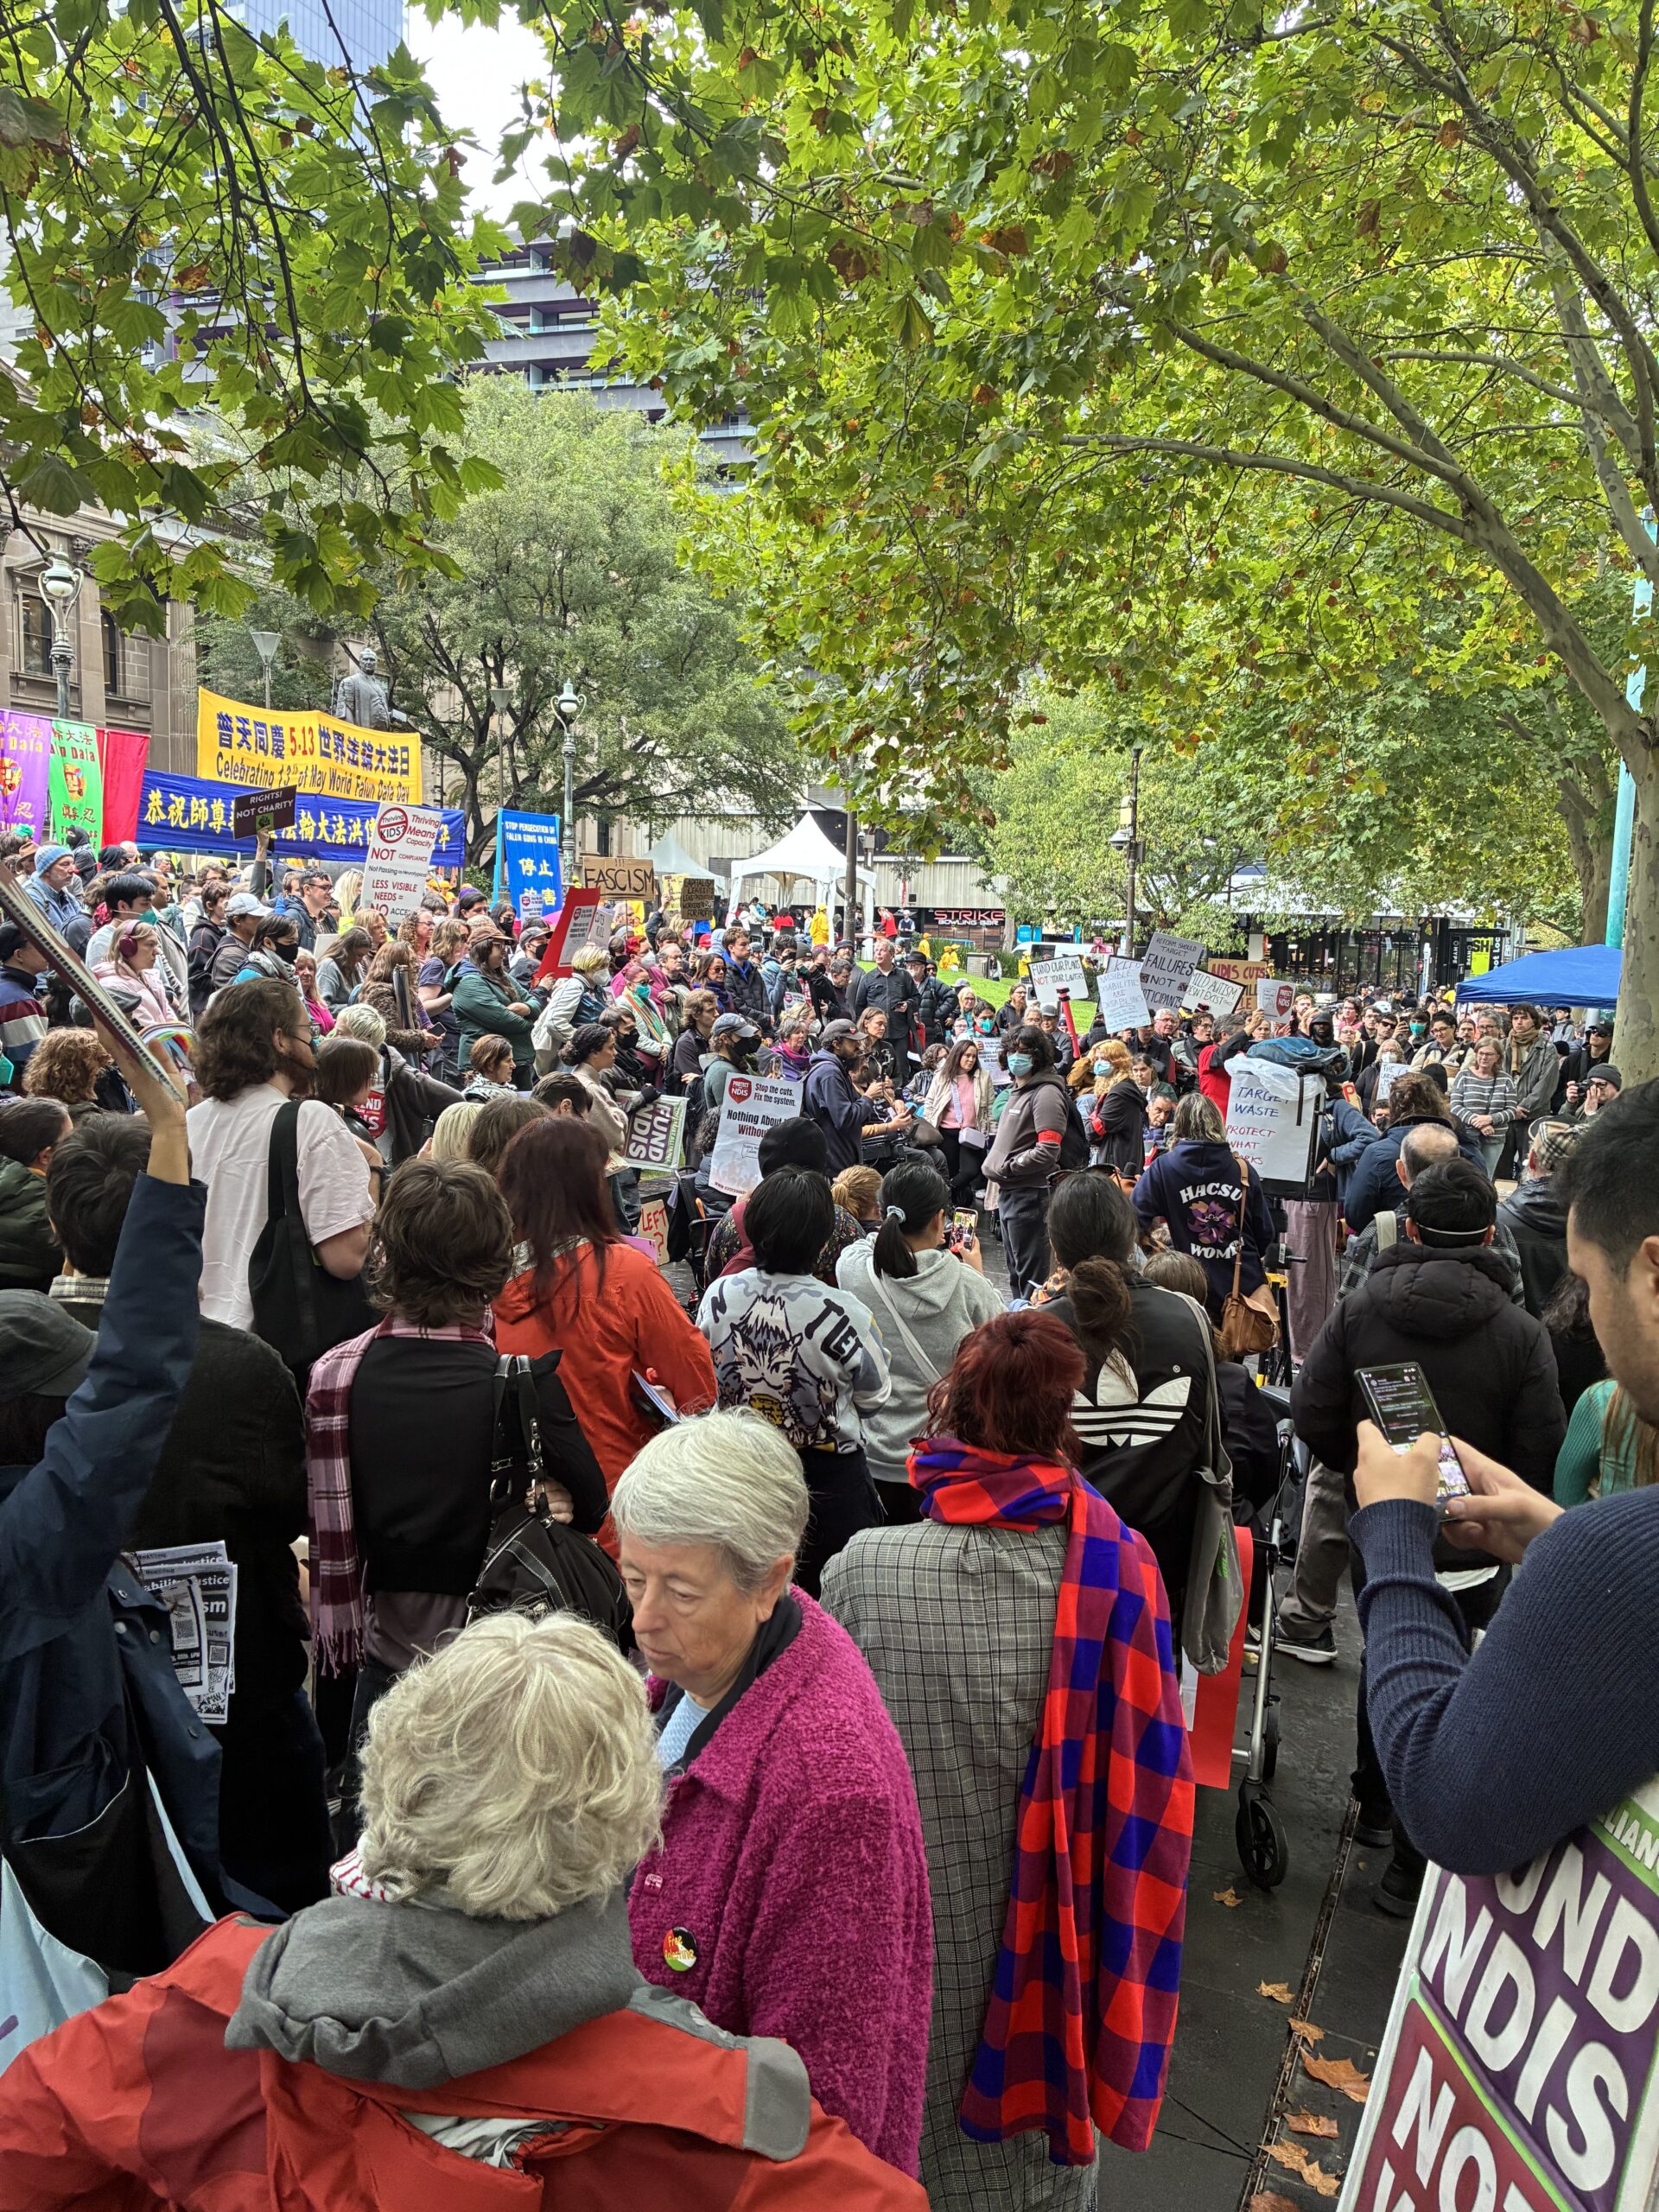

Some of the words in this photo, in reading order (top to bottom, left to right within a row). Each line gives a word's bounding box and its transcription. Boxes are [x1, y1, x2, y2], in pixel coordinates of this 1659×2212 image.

[216, 710, 285, 760] 普天同慶
[318, 723, 410, 778] 世界法輪大法日
[216, 751, 274, 788] Celebrating
[309, 764, 327, 793] May
[329, 767, 353, 791] World
[355, 774, 375, 799] Falun
[397, 781, 410, 804] Day
[250, 790, 283, 804] RIGHTS!
[144, 787, 235, 834] 恭祝師尊
[236, 808, 257, 819] NOT
[257, 799, 294, 815] CHARITY
[411, 814, 440, 829] Thriving
[505, 821, 518, 830] STOP
[380, 824, 406, 838] KIDS?
[407, 826, 436, 839] Means
[406, 837, 432, 849] Capacity
[371, 847, 397, 861] NOT
[398, 854, 429, 862] COMPLIANCE
[378, 866, 397, 875] Passing
[518, 857, 554, 877] 停止
[372, 879, 389, 889] LESS
[391, 881, 418, 893] VISIBLE
[585, 868, 655, 893] FASCISM
[374, 892, 397, 901] NEEDS
[934, 910, 1005, 921] STRIKE
[1160, 945, 1189, 957] TARGET
[1032, 963, 1051, 976] FUND
[1145, 953, 1196, 976] FAILURES
[1243, 966, 1266, 980] CUTS
[1033, 976, 1048, 986] NOT
[1149, 975, 1176, 988] NOT
[1208, 980, 1238, 1001] AUTISM
[1141, 988, 1184, 1009] RTICIPANTS
[731, 1088, 748, 1096] NDIS
[755, 1083, 769, 1093] Stop
[769, 1085, 779, 1094] the
[779, 1088, 794, 1096] cuts.
[1237, 1086, 1287, 1104] TARGE
[764, 1094, 773, 1103] the
[773, 1096, 796, 1107] system.
[727, 1109, 760, 1125] Nothing
[1235, 1103, 1279, 1117] WASTE
[629, 1103, 654, 1160] NDIS
[648, 1103, 671, 1162] FUND
[738, 1124, 768, 1138] Withou
[1226, 1124, 1276, 1138] PROTECT
[1179, 1182, 1243, 1204] HACSU
[641, 1208, 666, 1231] LEFT
[668, 1936, 683, 1947] Free
[1495, 1842, 1659, 2033] UND
[1420, 1873, 1629, 2192] NDIS
[1391, 2044, 1536, 2212] NO
